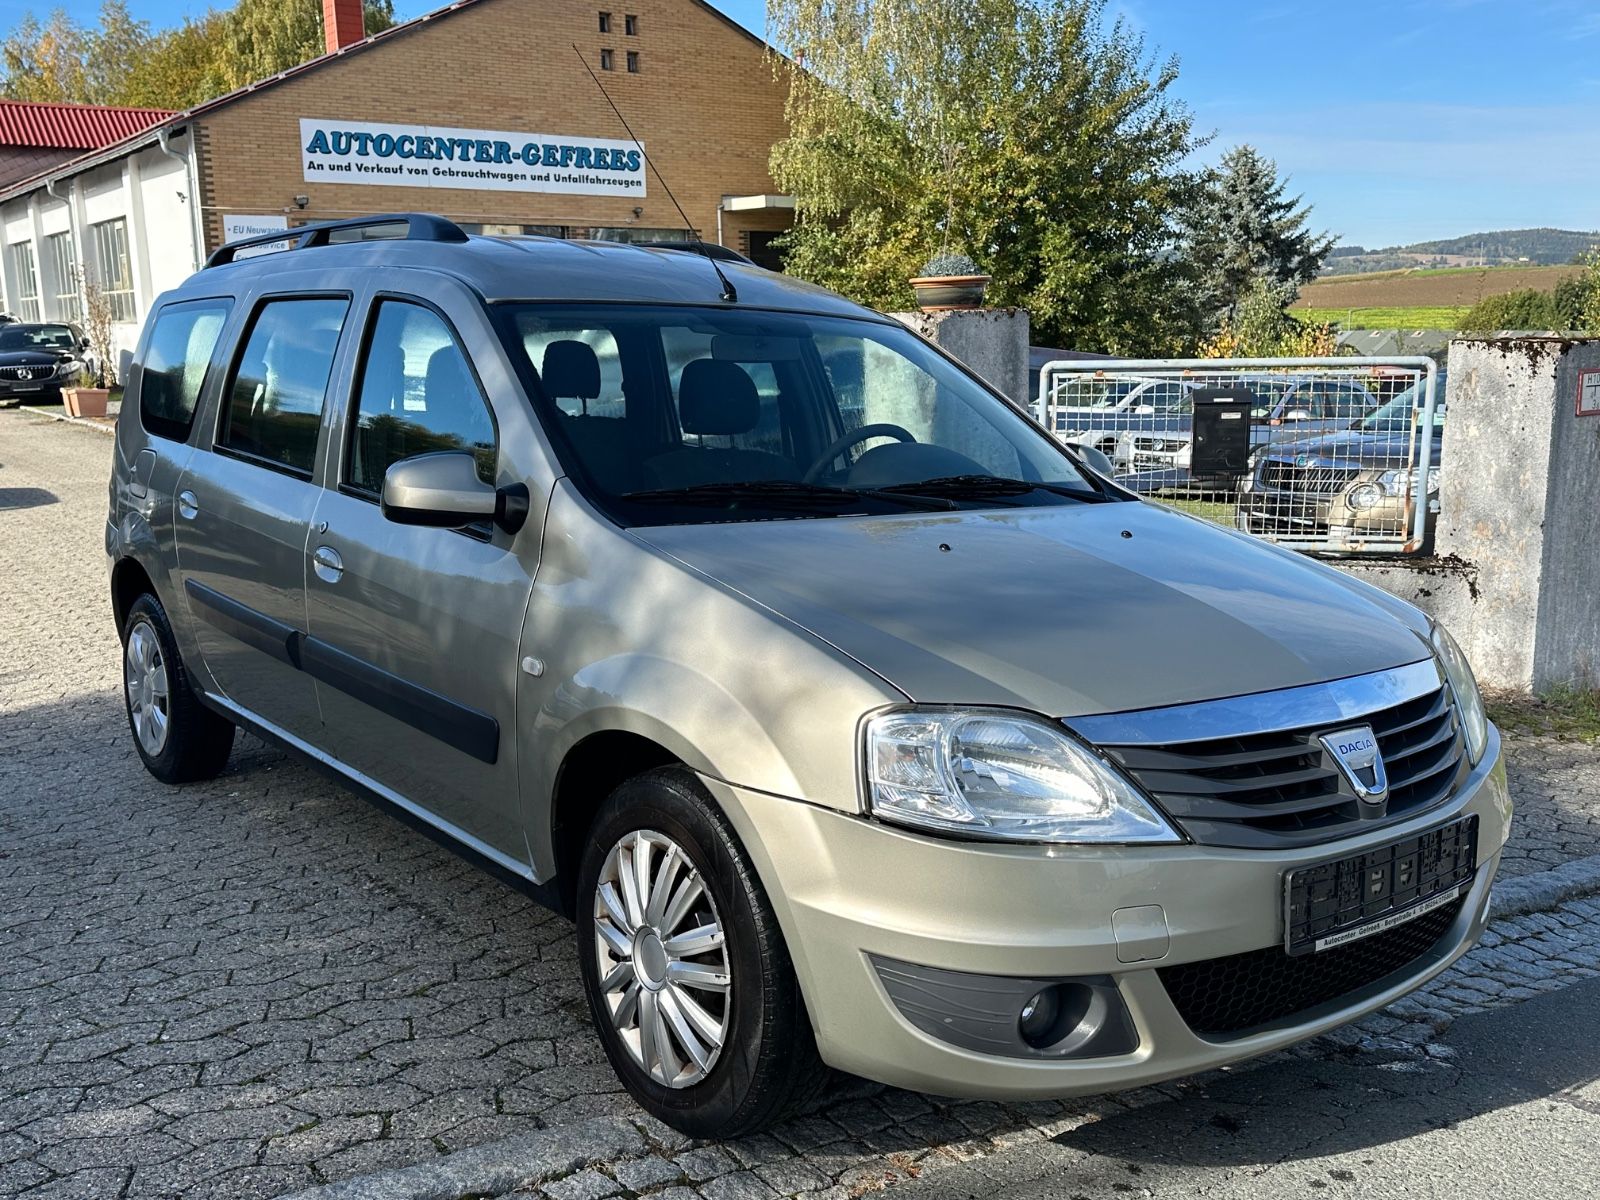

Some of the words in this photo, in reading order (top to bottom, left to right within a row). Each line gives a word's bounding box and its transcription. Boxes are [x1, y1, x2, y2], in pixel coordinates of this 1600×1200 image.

[306, 129, 641, 172] AUTOCENTER-GEFREES
[307, 161, 324, 170] An
[329, 162, 351, 172] und
[355, 163, 403, 174] Verkauf
[432, 166, 527, 182] Gebrauchtwagen
[530, 173, 551, 182] und
[554, 174, 642, 188] Unfallfahrzeugen
[233, 226, 244, 235] EU
[1339, 739, 1373, 755] DACIA
[1324, 932, 1357, 946] Autocenter
